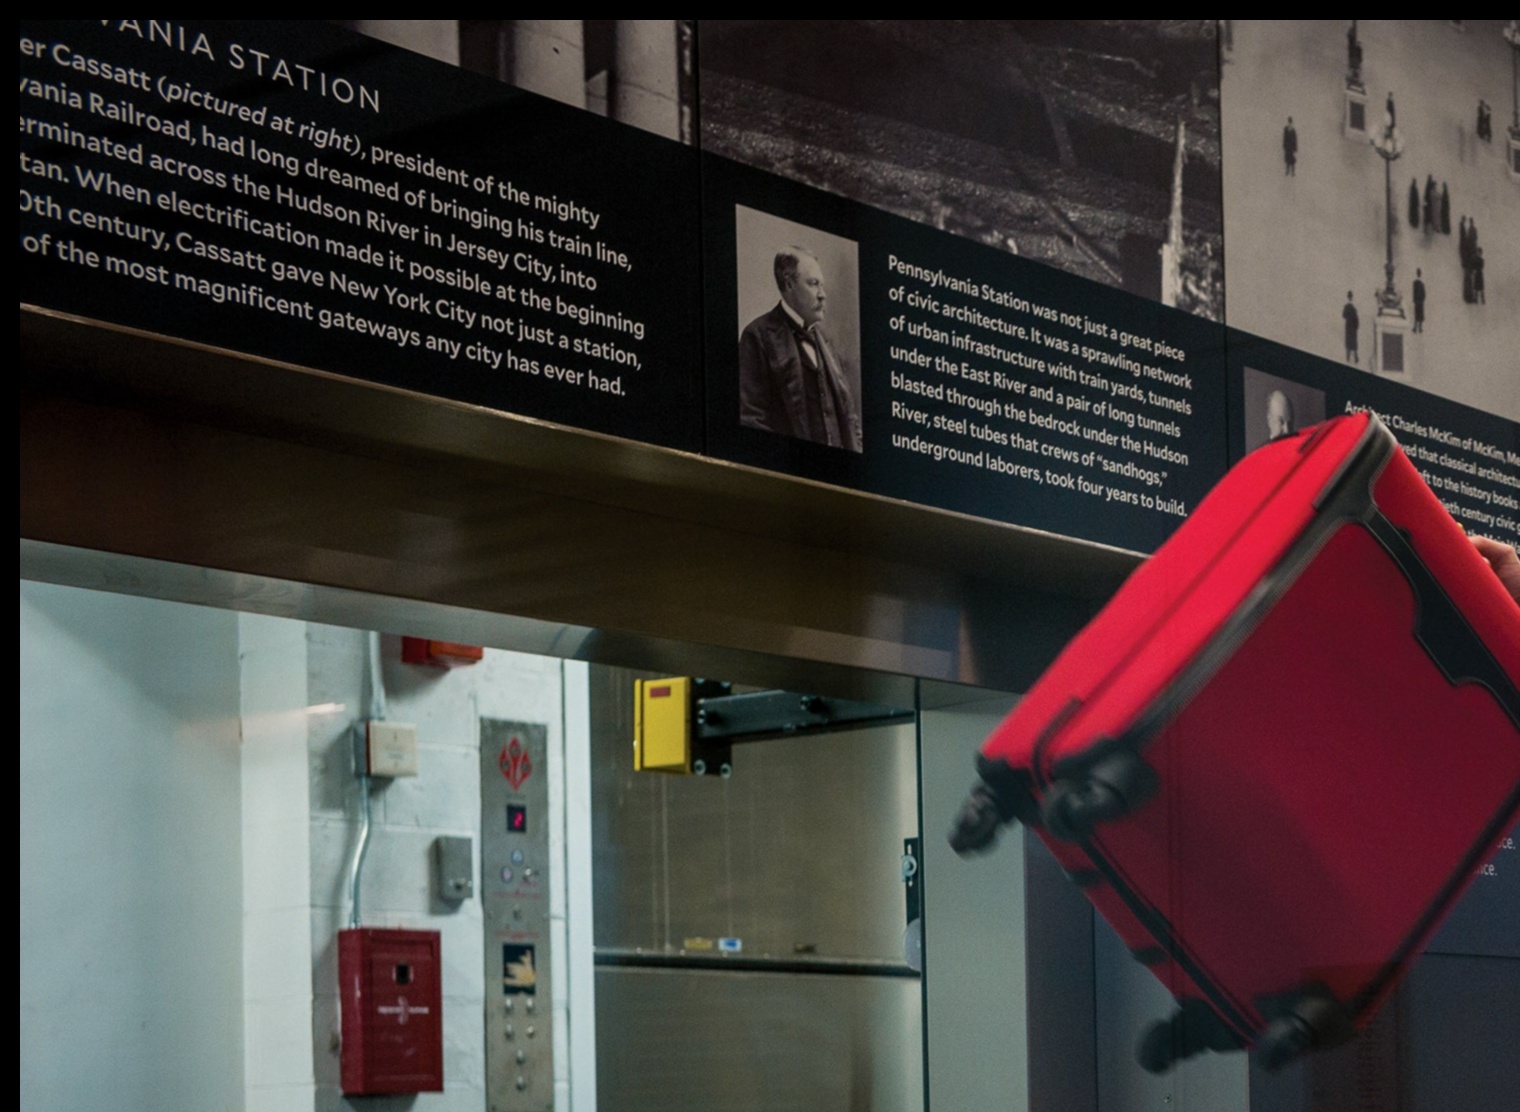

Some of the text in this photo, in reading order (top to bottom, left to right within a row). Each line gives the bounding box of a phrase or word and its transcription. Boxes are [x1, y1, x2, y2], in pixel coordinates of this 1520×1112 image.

[101, 19, 379, 113] ANIA STATION
[52, 43, 151, 92] Cassatt
[157, 75, 267, 126] (pictured
[270, 115, 295, 135] at
[298, 124, 366, 160] right),
[371, 145, 469, 188] president
[473, 175, 494, 195] of
[497, 181, 530, 206] the
[534, 195, 600, 230] mighty
[89, 92, 197, 146] Railroad,
[202, 125, 245, 157] had
[251, 139, 299, 177] long
[305, 157, 399, 202] dreamed
[404, 189, 426, 209] of
[430, 192, 513, 238] bringing
[517, 218, 545, 244] his
[548, 229, 592, 258] train
[596, 241, 632, 272] line,
[74, 165, 151, 205] When
[157, 191, 320, 251] electrification
[325, 238, 384, 267] made
[389, 254, 404, 273] it
[409, 261, 492, 296] possible
[495, 284, 516, 303] at
[520, 287, 552, 312] the
[556, 295, 645, 341] beginning
[149, 153, 227, 188] across
[232, 173, 271, 201] the
[276, 184, 361, 226] Hudson
[366, 209, 420, 241] River
[424, 230, 442, 249] in
[446, 233, 510, 270] Jersey
[513, 252, 557, 283] City,
[560, 268, 597, 291] into
[23, 234, 626, 396] of the most magnificent gateways any city has ever had.
[68, 208, 170, 251] century,
[176, 232, 266, 273] Cassatt
[271, 261, 324, 287] gave
[330, 270, 379, 301] New
[383, 284, 431, 315] York
[435, 299, 477, 329] City
[481, 314, 514, 336] not
[517, 324, 554, 346] just
[558, 334, 569, 350] a
[573, 337, 642, 371] station,
[888, 254, 1185, 362] Pennsylvania Station was not just a great piece
[888, 285, 1192, 390] of civic architecture. It was a sprawling network
[889, 315, 1192, 416] of urban infrastructure with train yards, tunnels
[890, 346, 1181, 438] under the East River and a pair of long tunnels
[891, 370, 1189, 466] blasted through the bedrock under the Hudson
[892, 400, 931, 429] River,
[933, 415, 967, 435] steel
[969, 422, 1008, 446] tubes
[1010, 432, 1039, 454] that
[1040, 443, 1080, 464] crews
[1081, 451, 1095, 467] of
[1392, 414, 1428, 438] Charles
[1428, 426, 1462, 448] McKim
[1461, 437, 1473, 451] of
[1472, 440, 1507, 464] McKim,
[892, 434, 1188, 519] underground laborers, took four years to build.
[1431, 474, 1443, 488] to
[1443, 477, 1460, 493] the
[1460, 481, 1492, 505] history
[1492, 490, 1519, 510] books
